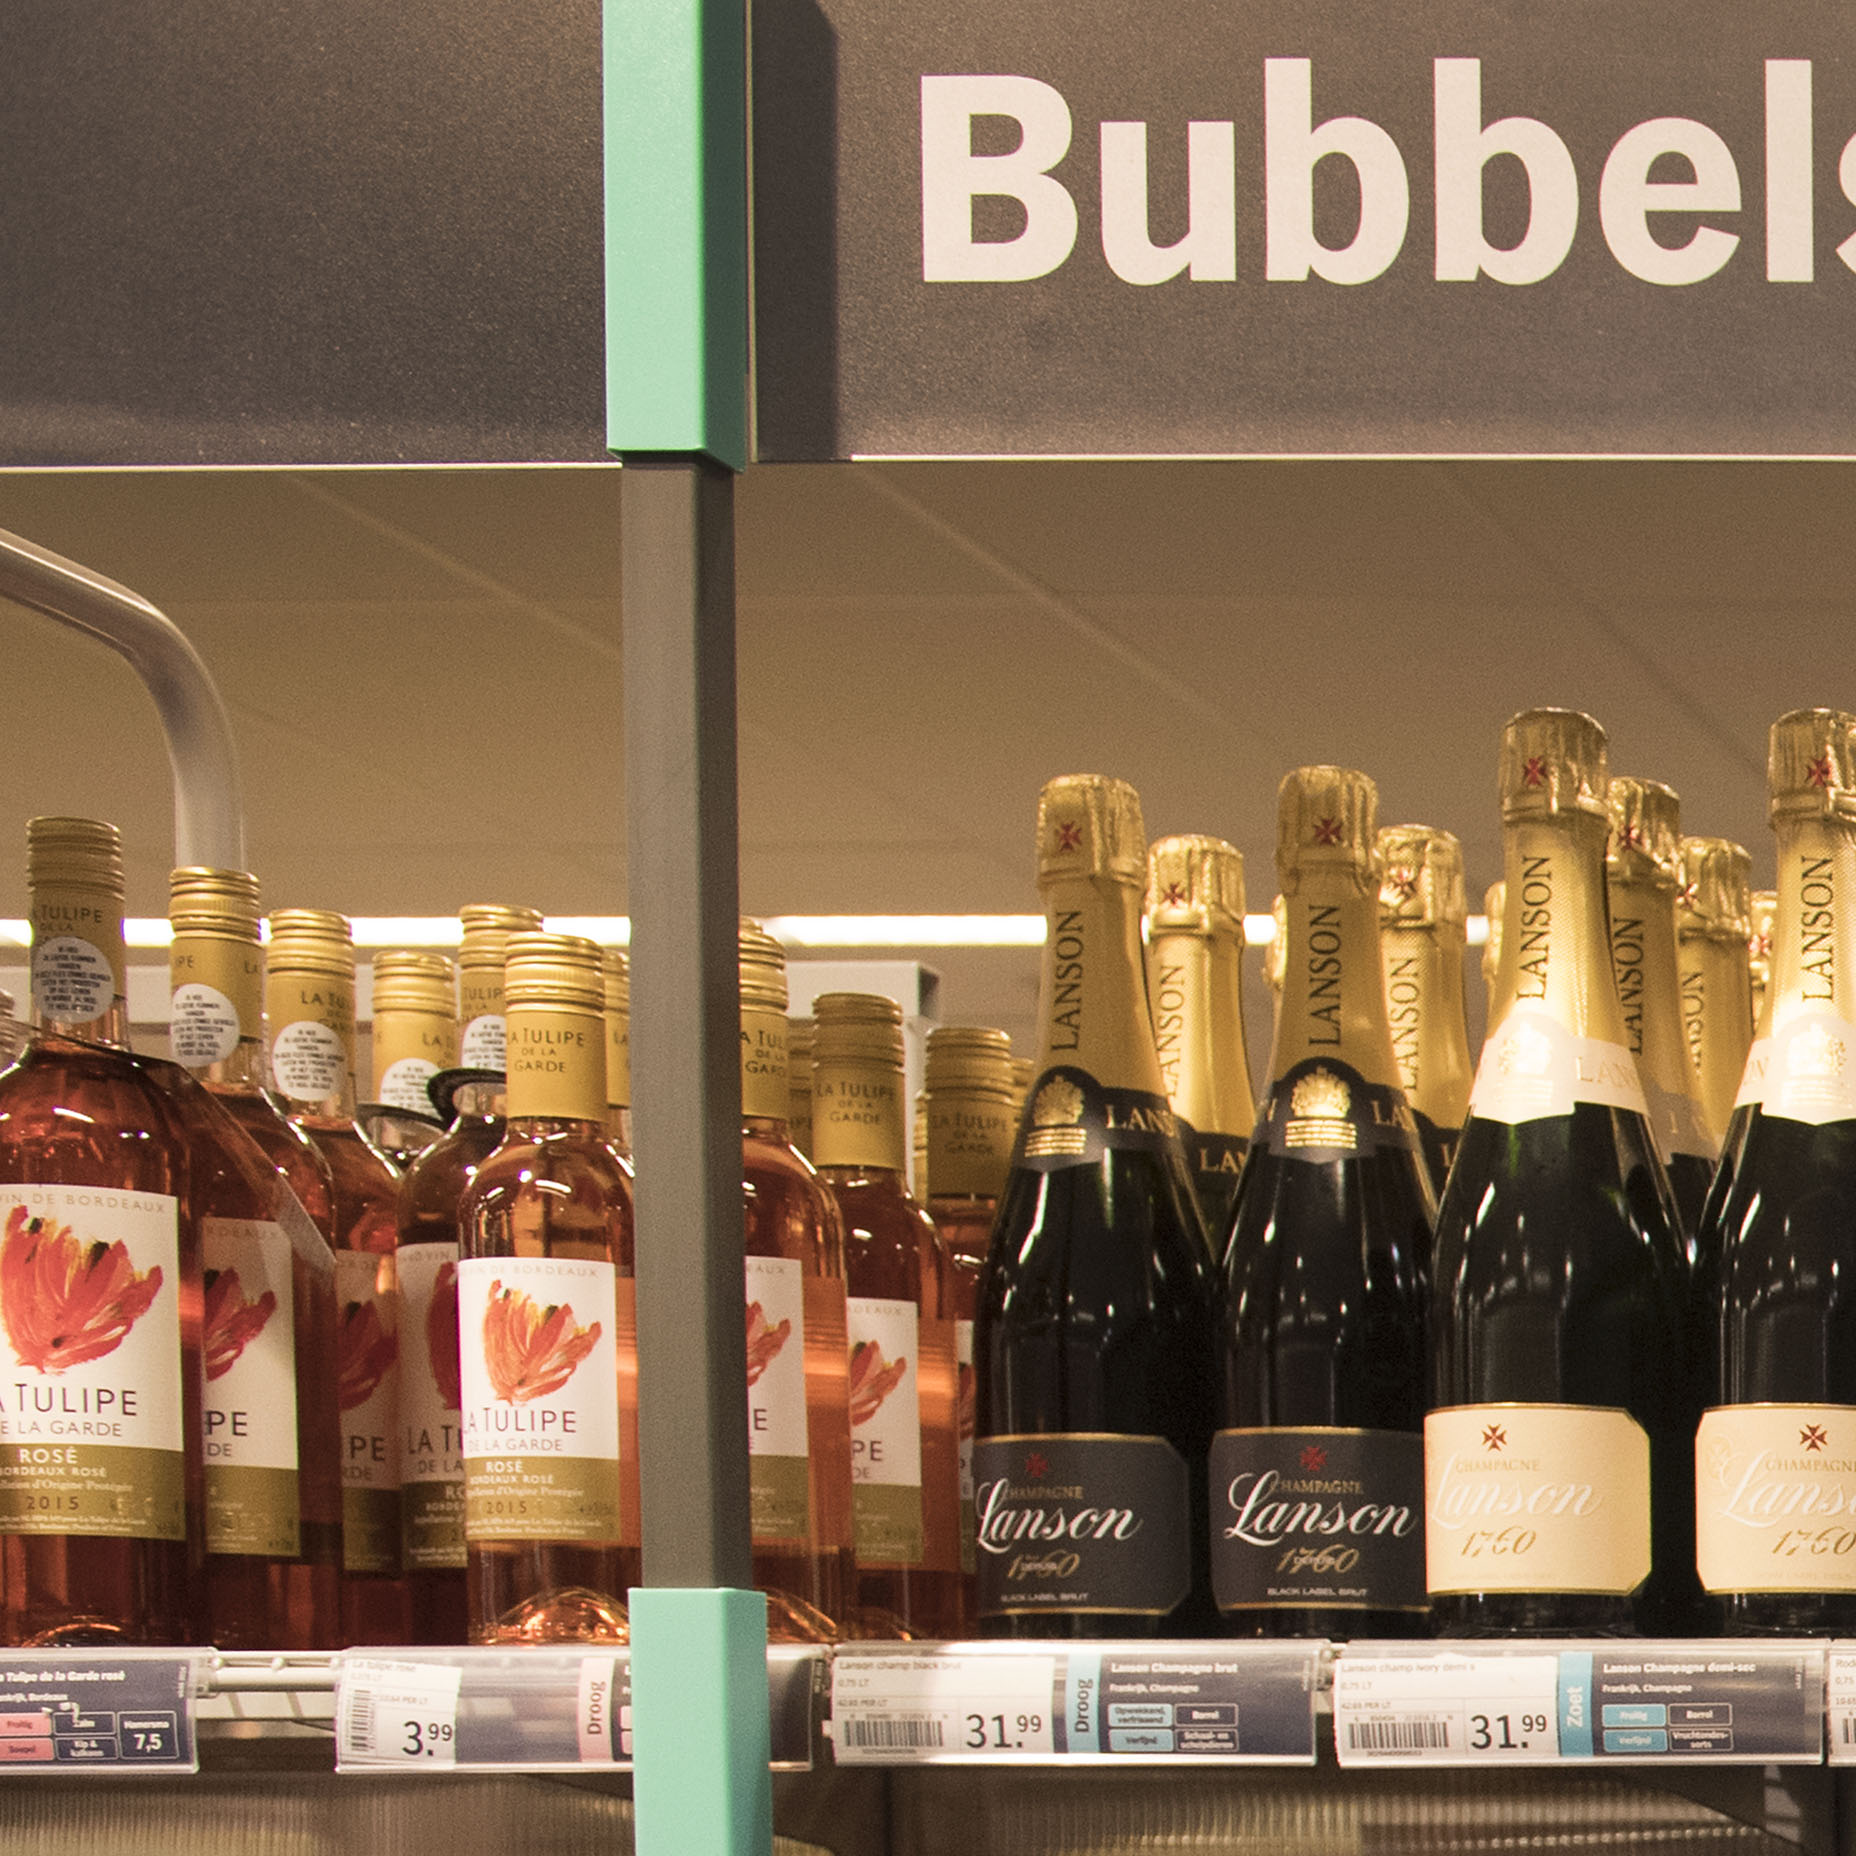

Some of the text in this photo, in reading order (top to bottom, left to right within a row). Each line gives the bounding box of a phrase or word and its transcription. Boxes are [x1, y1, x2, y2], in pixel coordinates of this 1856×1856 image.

[1050, 909, 1084, 1052] LANSON
[1517, 853, 1553, 1002] LANSON
[1802, 853, 1836, 1002] LANSON
[16, 1383, 138, 1416] TULIPE
[1225, 1469, 1418, 1544] Lanson
[1567, 1686, 1584, 1729] Zoet
